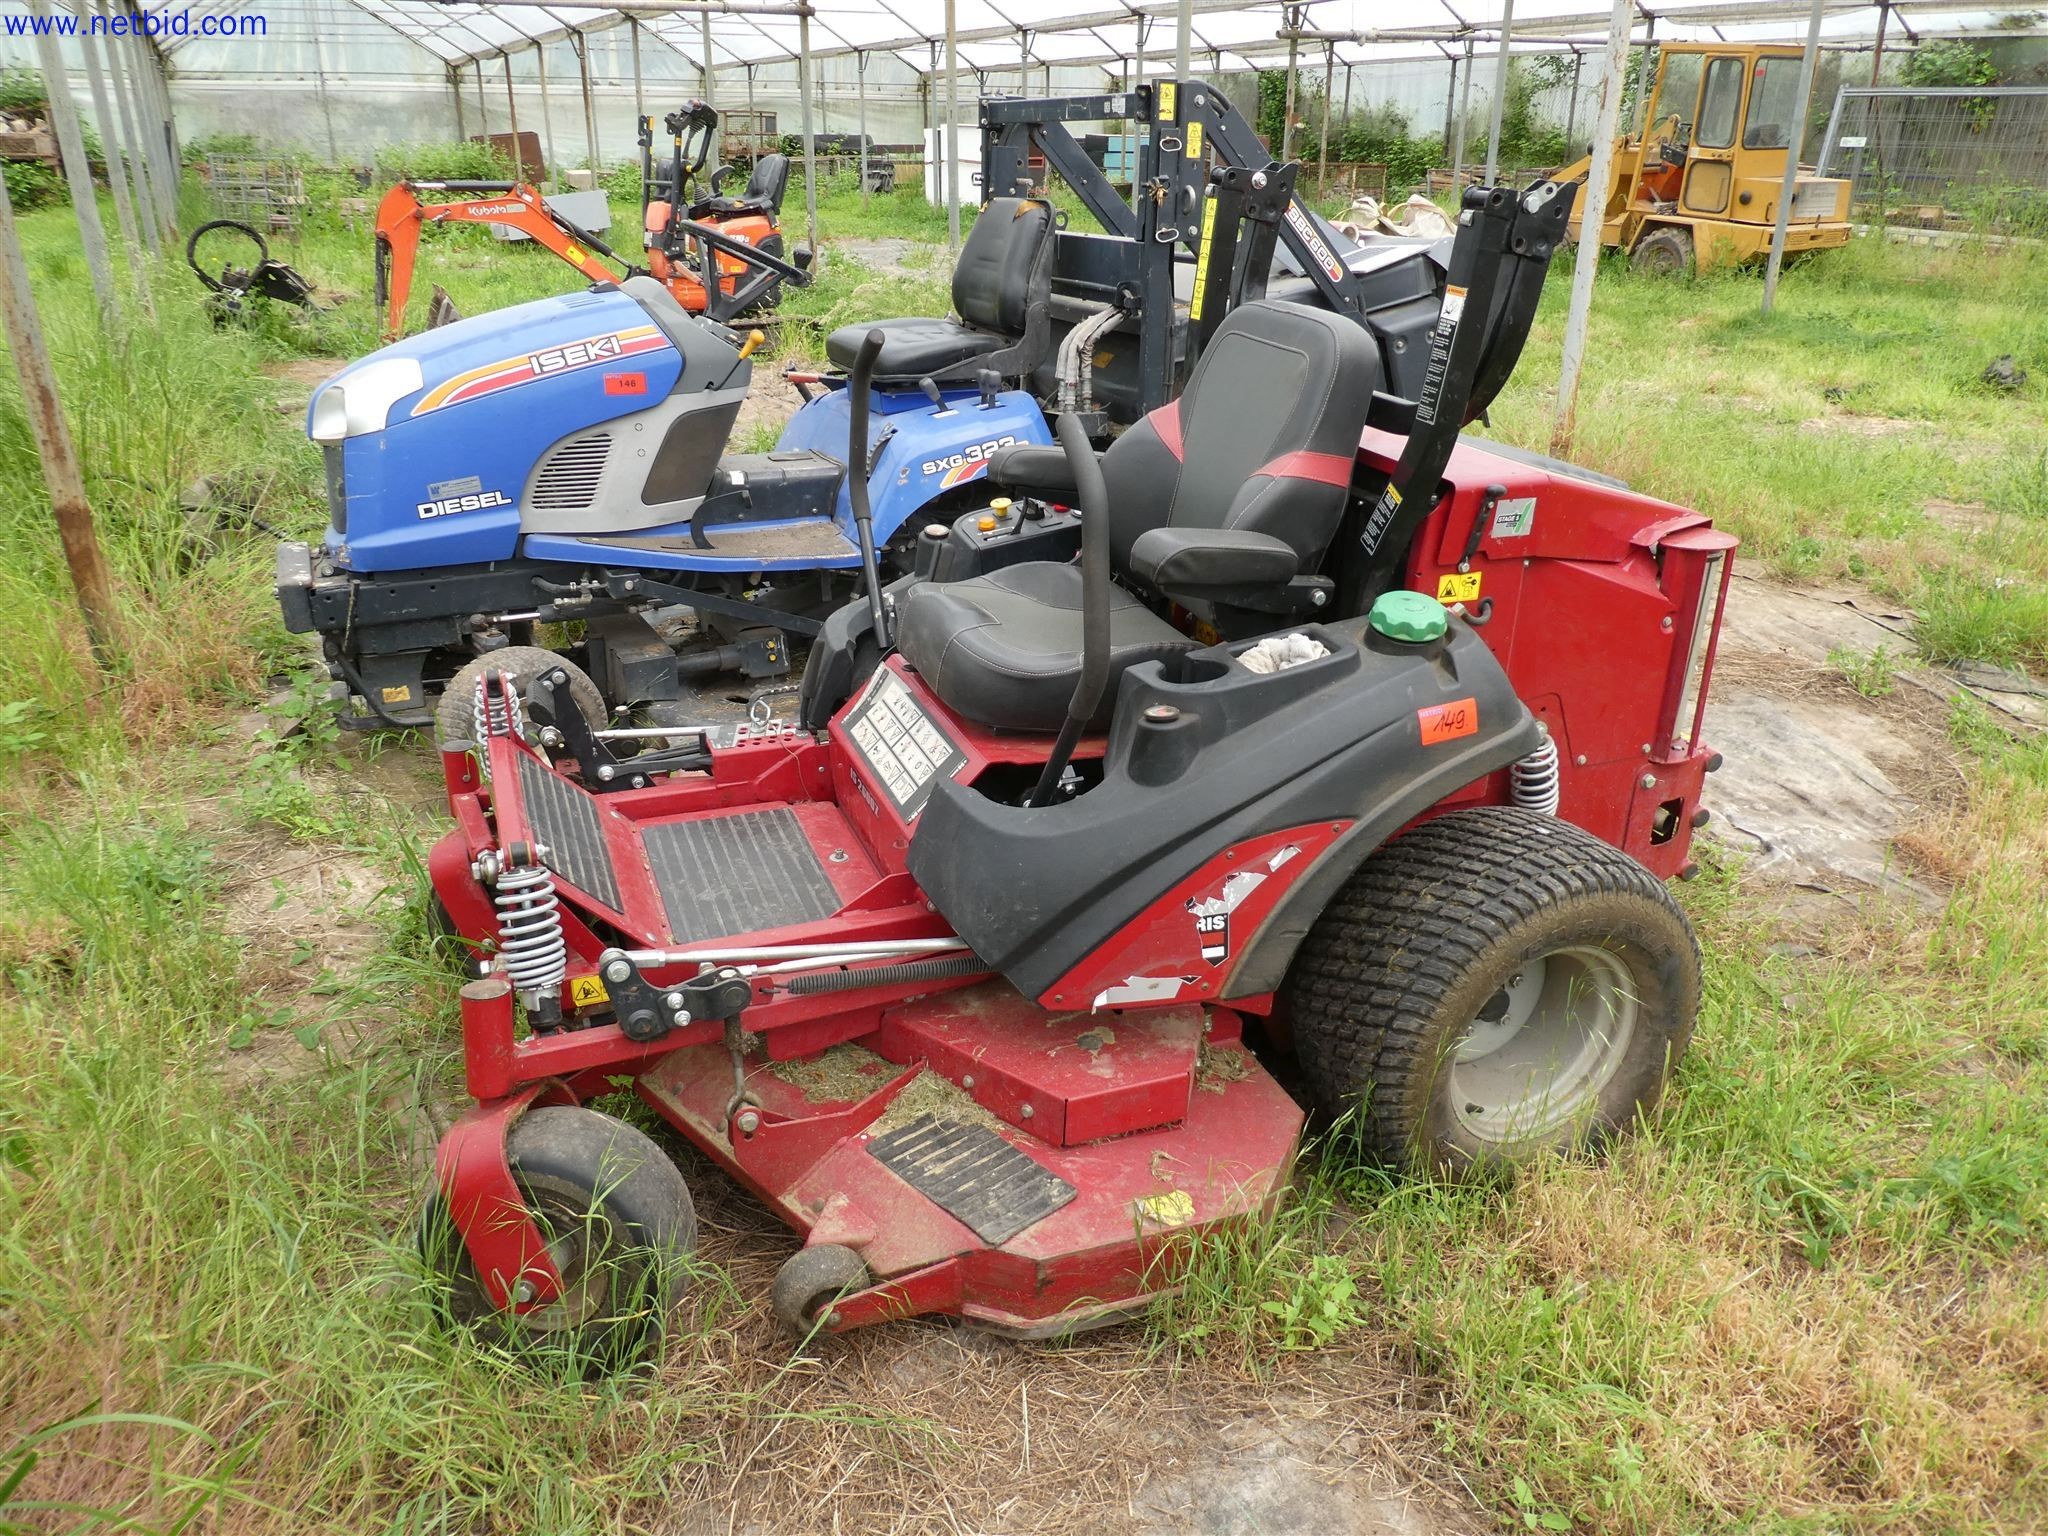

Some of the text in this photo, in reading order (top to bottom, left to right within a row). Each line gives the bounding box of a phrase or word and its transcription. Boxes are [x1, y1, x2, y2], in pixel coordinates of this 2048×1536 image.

[468, 205, 507, 216] Kubota
[529, 335, 623, 375] ISEKI
[417, 490, 513, 519] DIESEL
